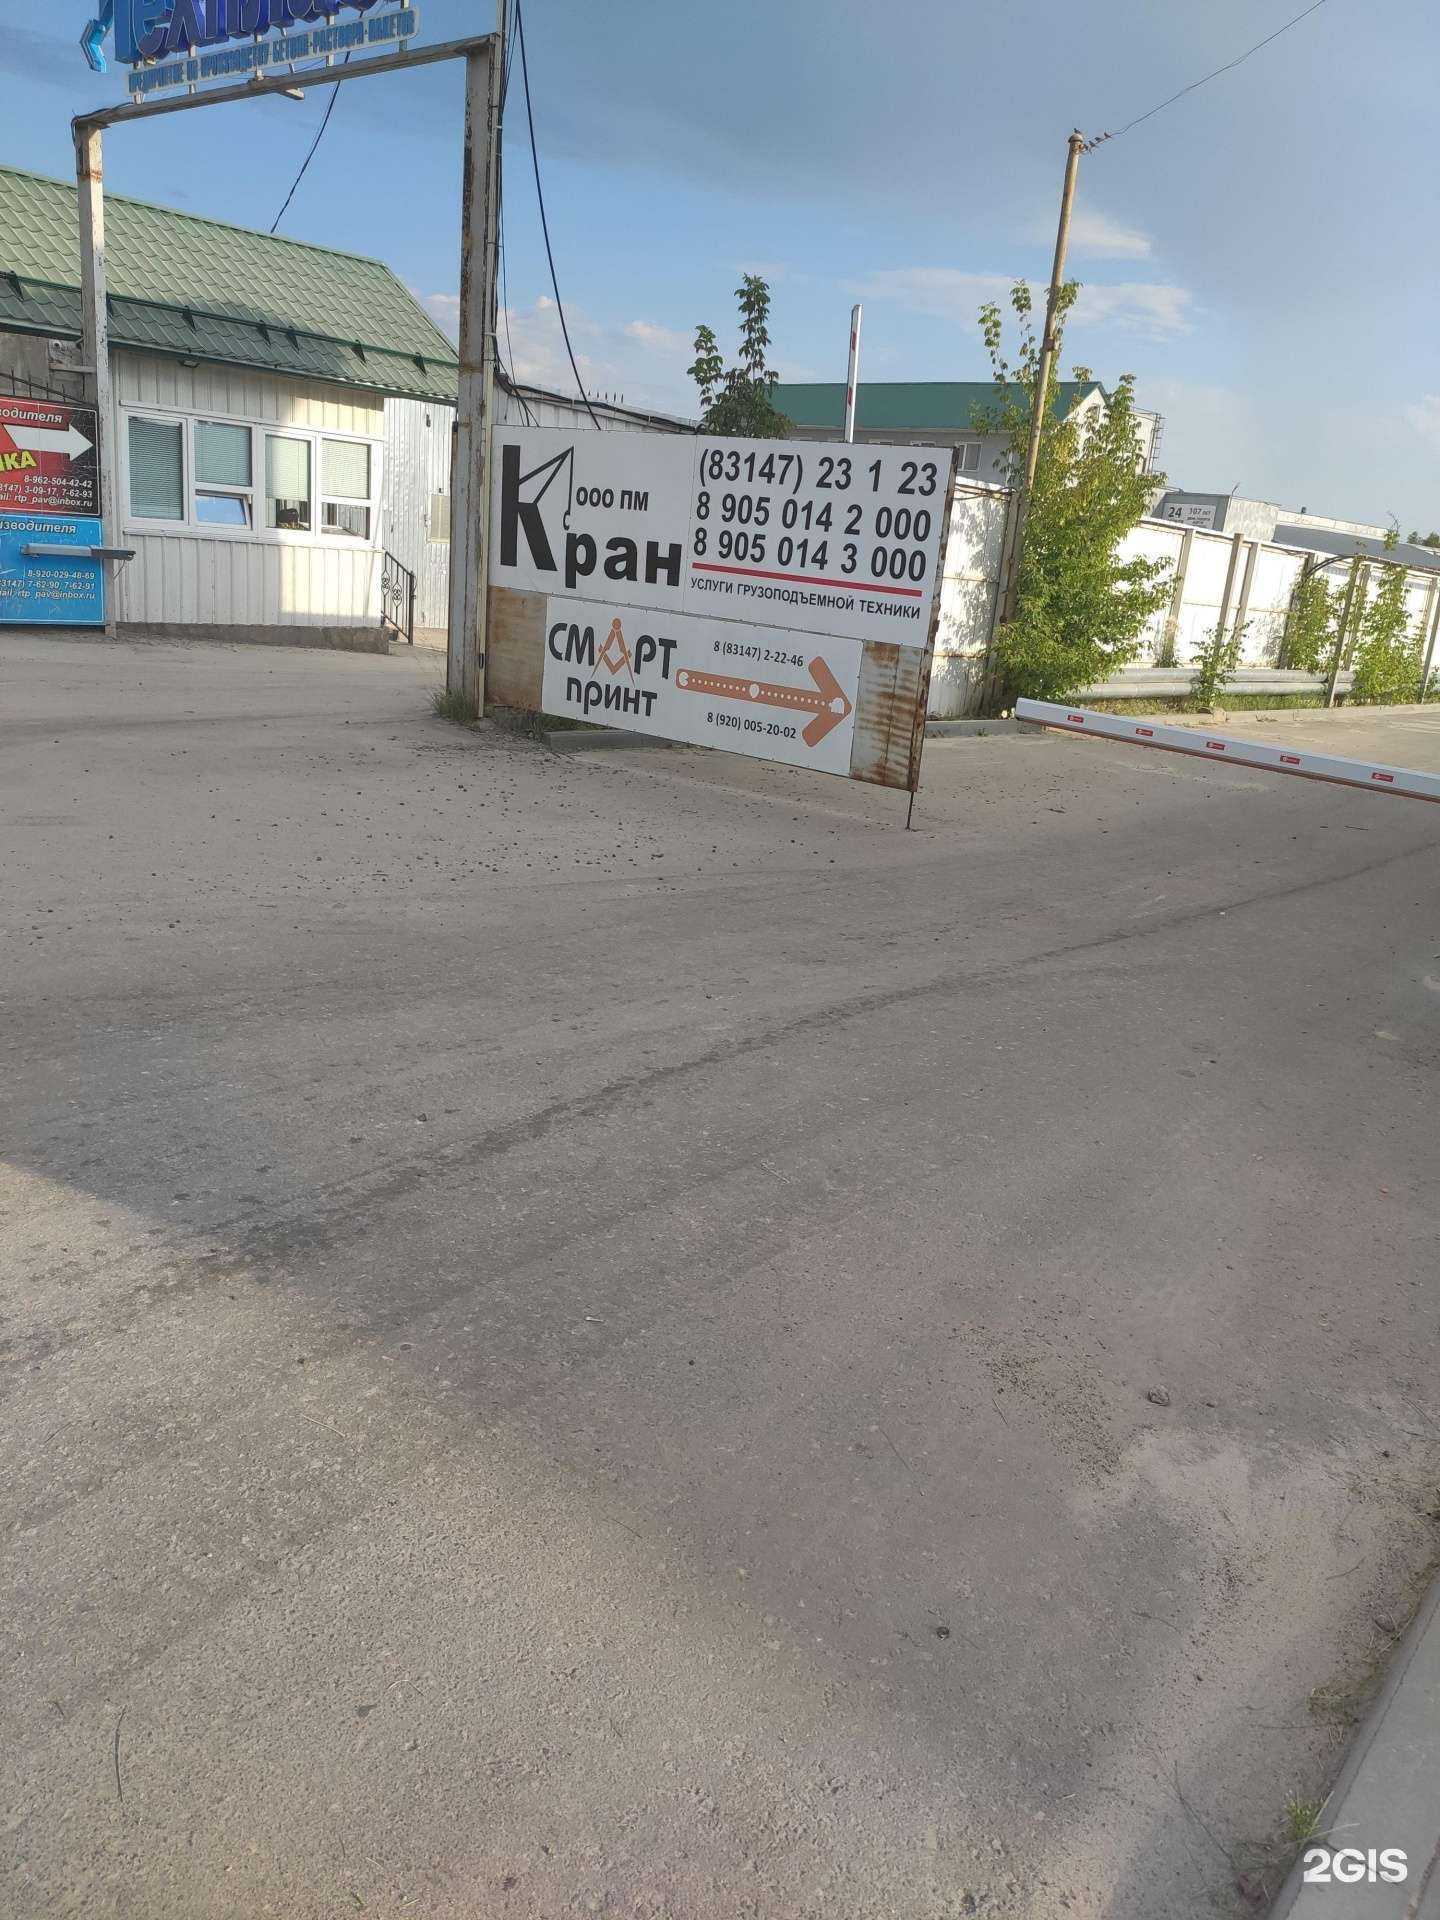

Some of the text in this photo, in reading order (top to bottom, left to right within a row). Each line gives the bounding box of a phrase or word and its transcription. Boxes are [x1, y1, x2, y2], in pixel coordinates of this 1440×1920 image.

[0, 407, 63, 424] одителя
[24, 474, 93, 488] 8-962-504-42-42
[700, 448, 938, 496] (83147) 23 1 23
[620, 489, 650, 512] ПМ
[696, 491, 931, 542] 8 905 014 2 000
[693, 527, 927, 582] 8 905 014 3 000
[690, 576, 921, 620] УСЛУГИ ГРУЗОПОДЪЕМНОЙ ТЕХНИКИ
[713, 640, 804, 667] 8 (83147) 2-22-46
[707, 712, 797, 739] 8 (920) 005-20-02
